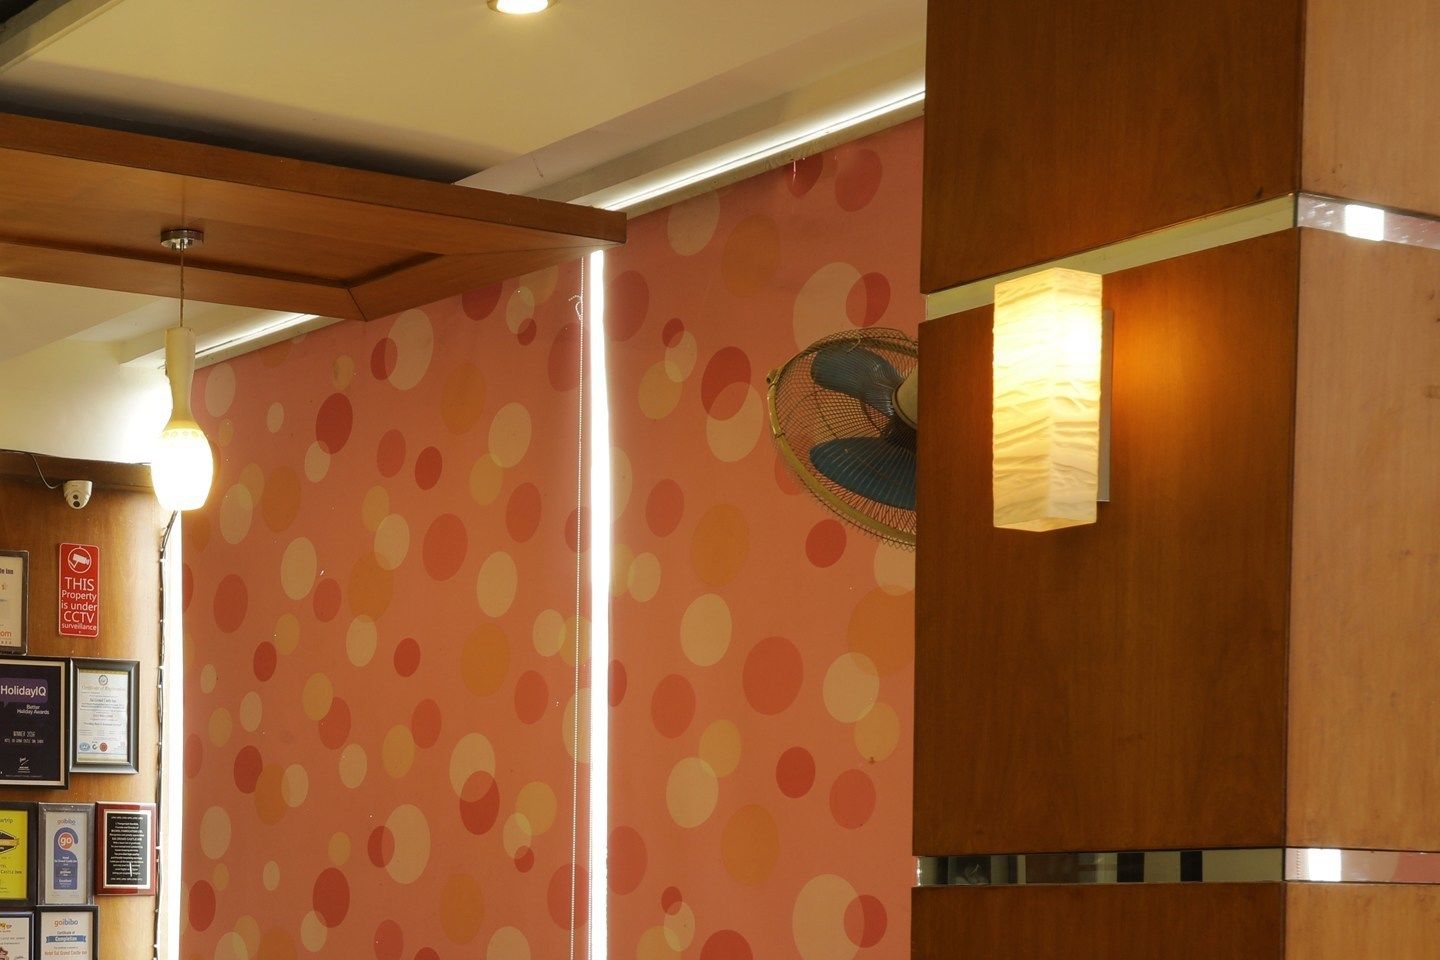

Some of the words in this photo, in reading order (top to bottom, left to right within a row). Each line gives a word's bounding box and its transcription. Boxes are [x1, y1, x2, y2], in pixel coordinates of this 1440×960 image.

[64, 577, 94, 591] THIS
[62, 590, 96, 602] Property
[61, 600, 68, 609] is
[70, 602, 98, 611] under
[64, 611, 94, 623] CCTV
[0, 685, 46, 698] HolidayIQ
[61, 838, 72, 846] go
[54, 918, 78, 927] goibibo
